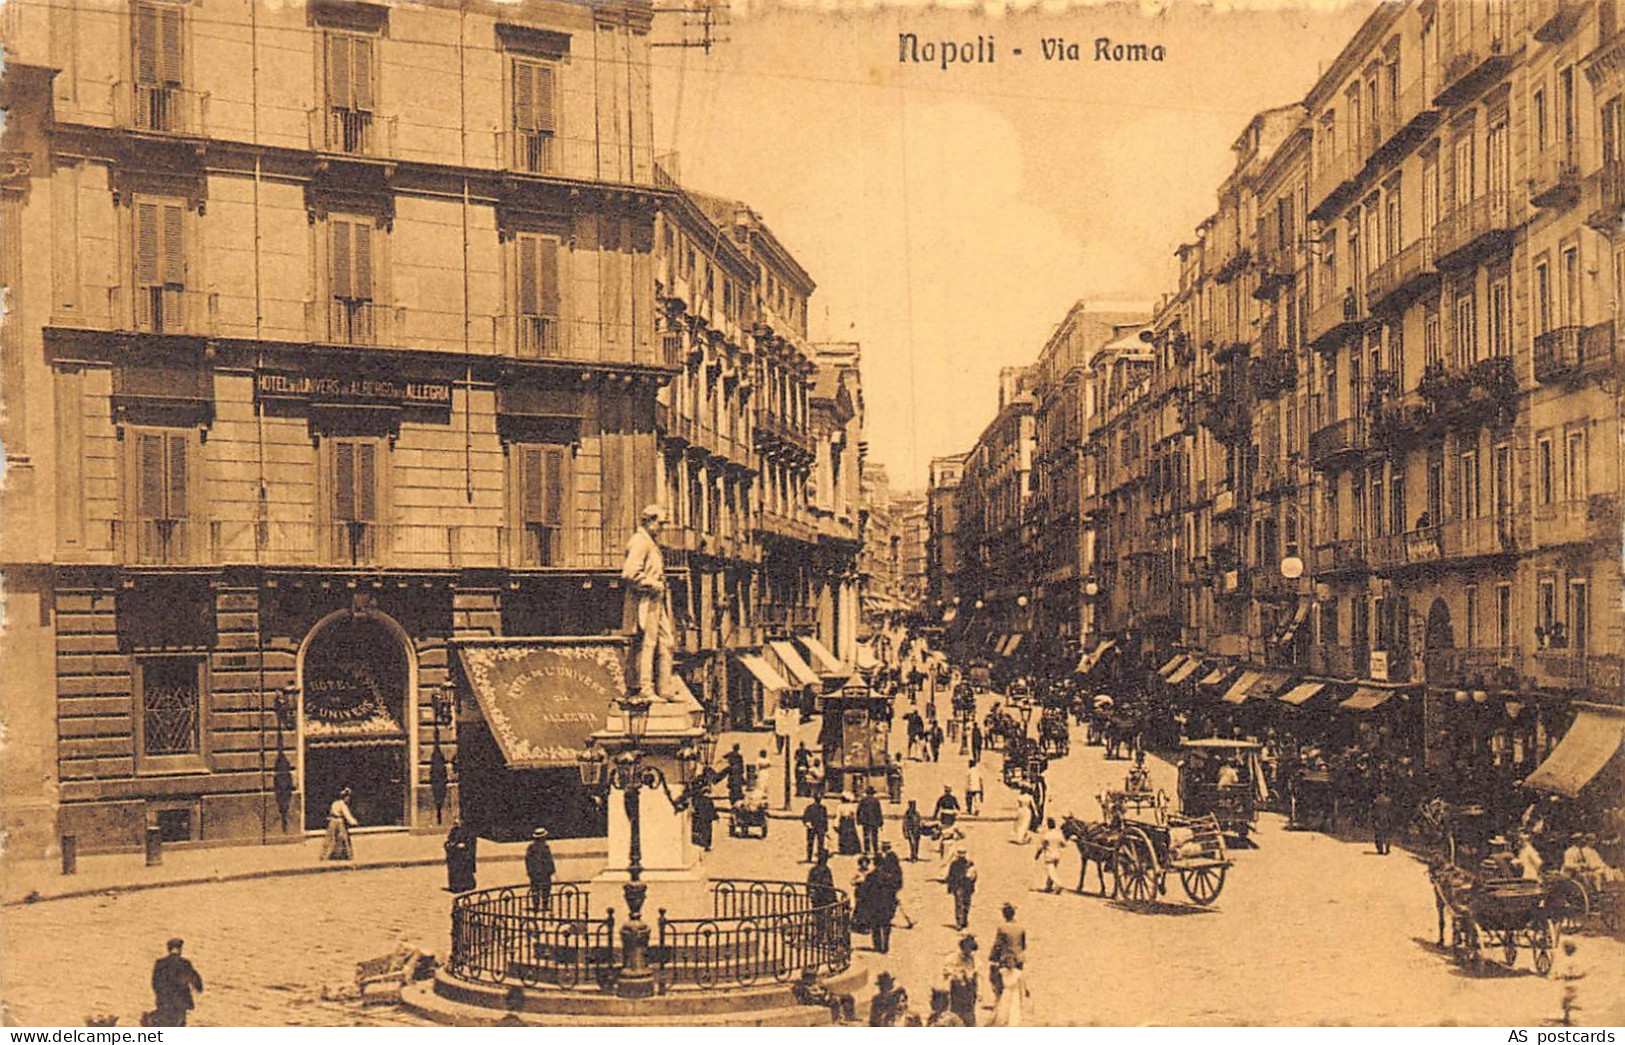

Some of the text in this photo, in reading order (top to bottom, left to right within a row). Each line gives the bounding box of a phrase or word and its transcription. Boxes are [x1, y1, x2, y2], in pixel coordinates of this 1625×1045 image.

[258, 375, 288, 393] HOTEL
[406, 383, 450, 401] ALLEGRIA
[310, 680, 356, 691] HOTEL
